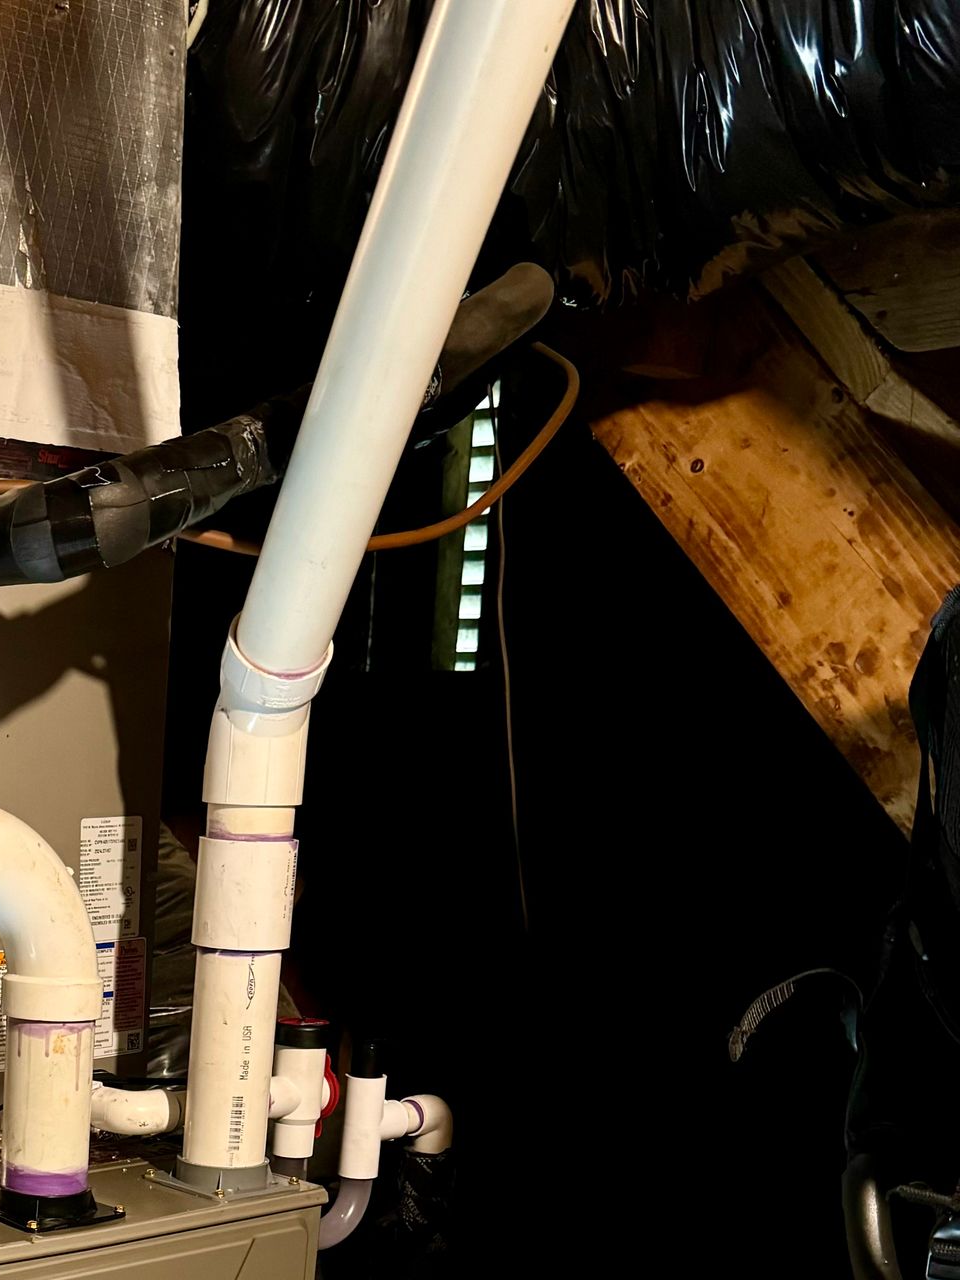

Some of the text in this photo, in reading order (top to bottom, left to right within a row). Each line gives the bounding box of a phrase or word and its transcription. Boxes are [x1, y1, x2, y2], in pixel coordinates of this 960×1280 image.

[240, 1025, 252, 1080] Made in USA
